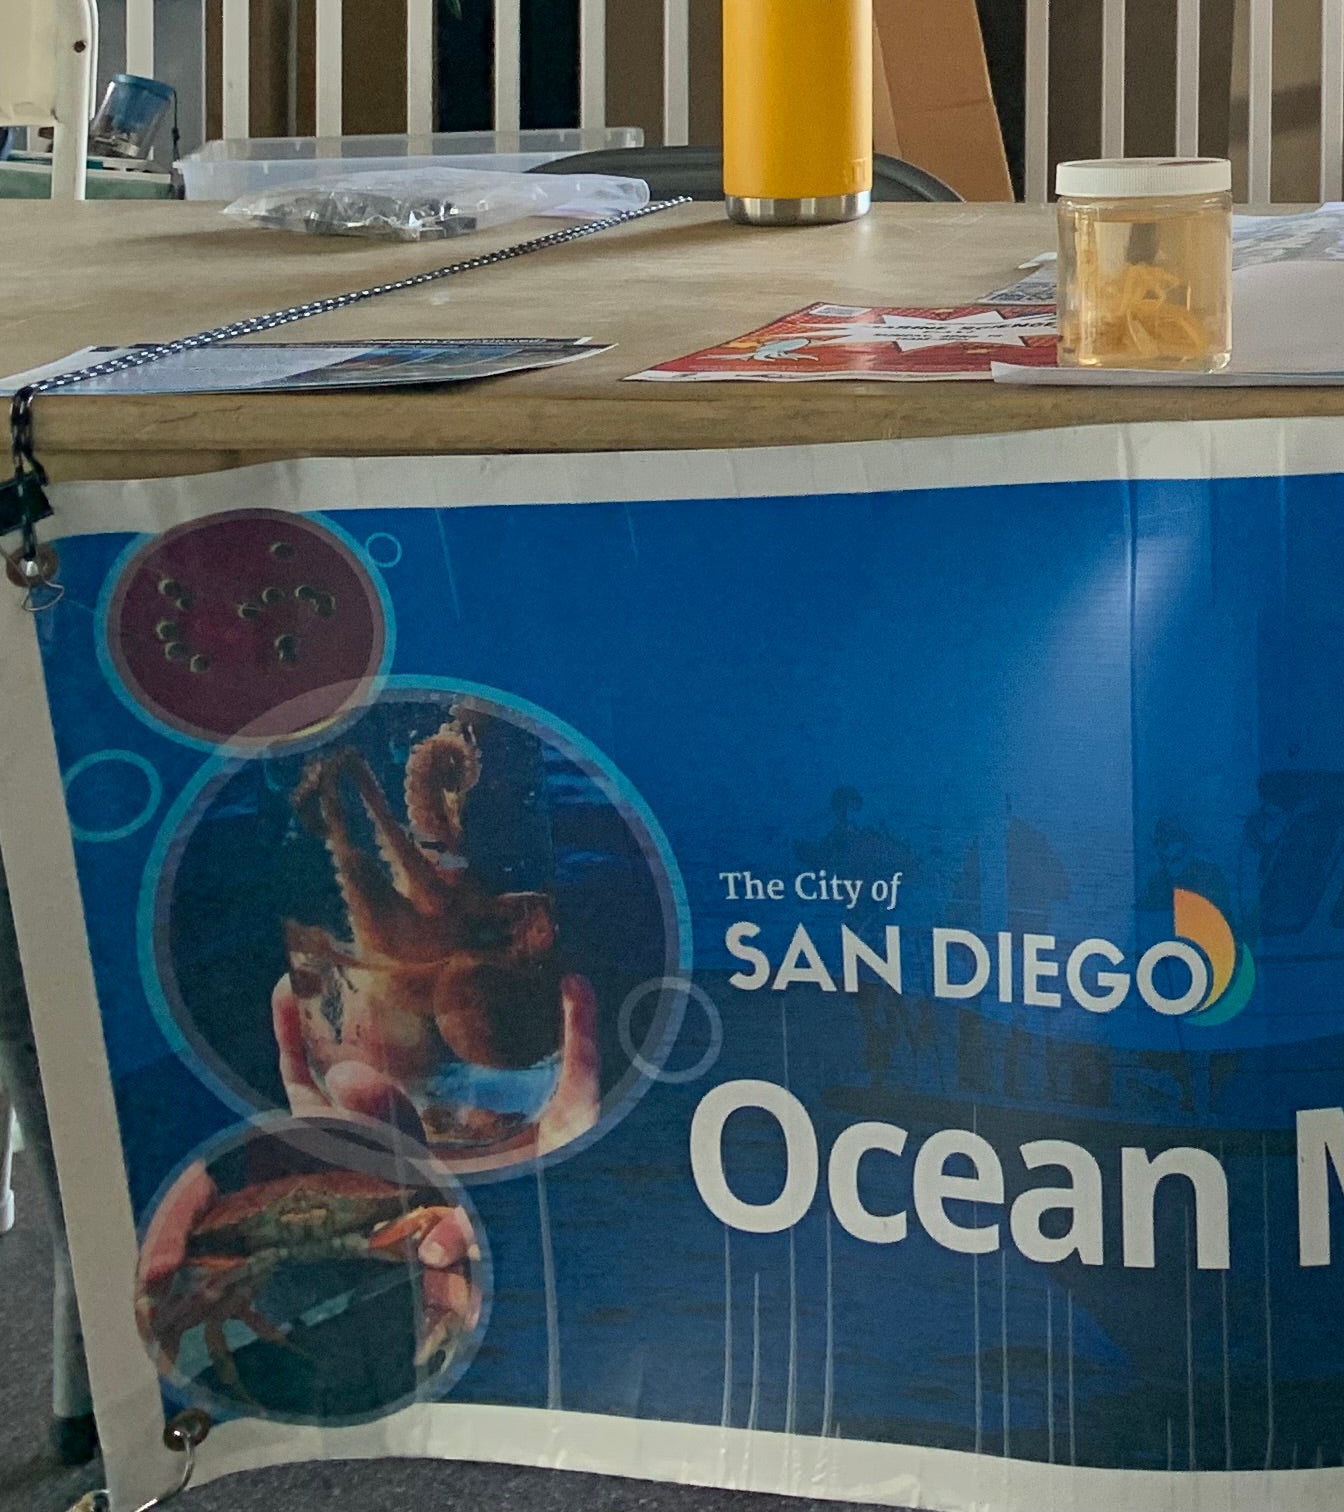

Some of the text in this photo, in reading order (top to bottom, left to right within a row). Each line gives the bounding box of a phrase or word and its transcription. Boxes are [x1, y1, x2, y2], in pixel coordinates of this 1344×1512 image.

[719, 869, 904, 912] The City of
[724, 920, 1208, 1017] SAN DIEGO
[688, 1078, 1231, 1271] Ocean
